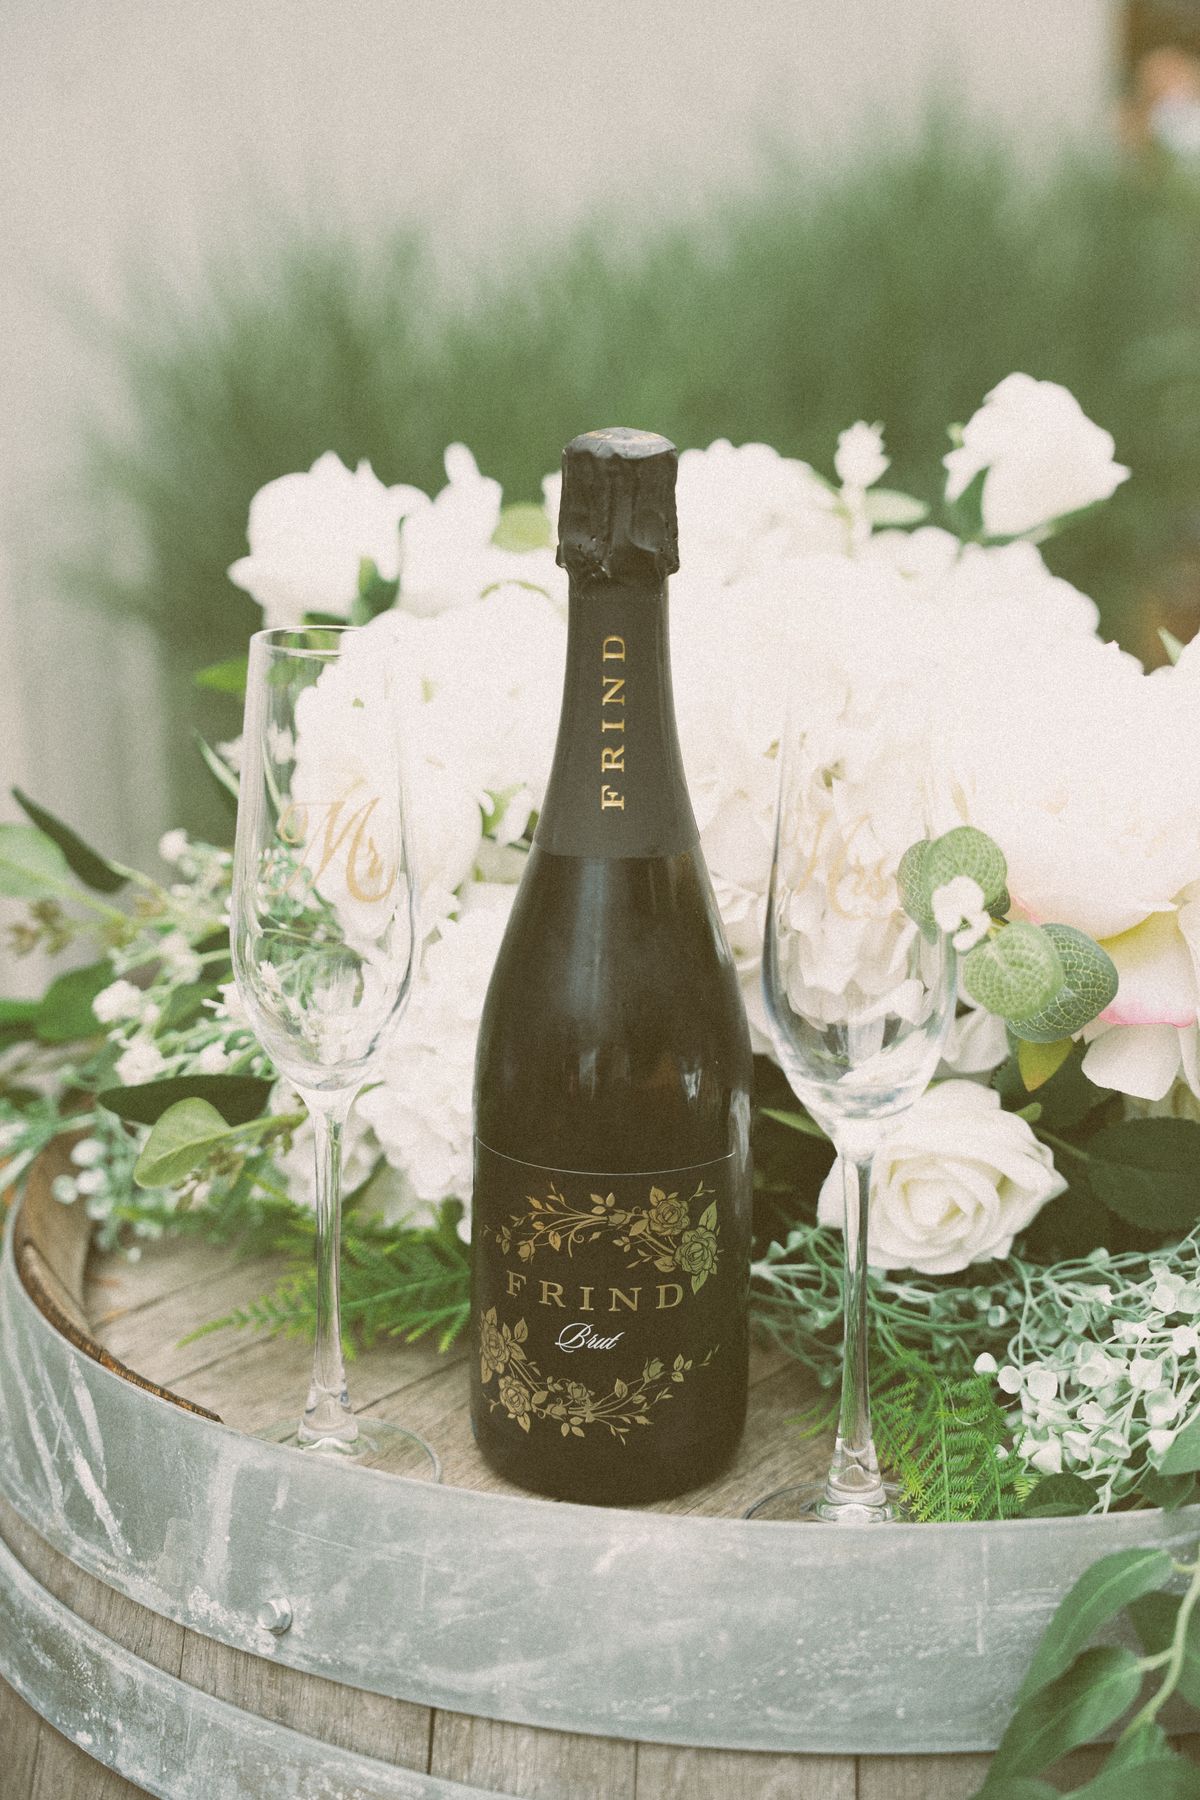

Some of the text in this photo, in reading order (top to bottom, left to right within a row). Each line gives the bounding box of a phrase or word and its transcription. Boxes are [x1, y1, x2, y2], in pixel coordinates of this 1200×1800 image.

[601, 635, 626, 811] FRIND
[506, 1270, 684, 1312] FRIND
[555, 1322, 625, 1353] Brut
